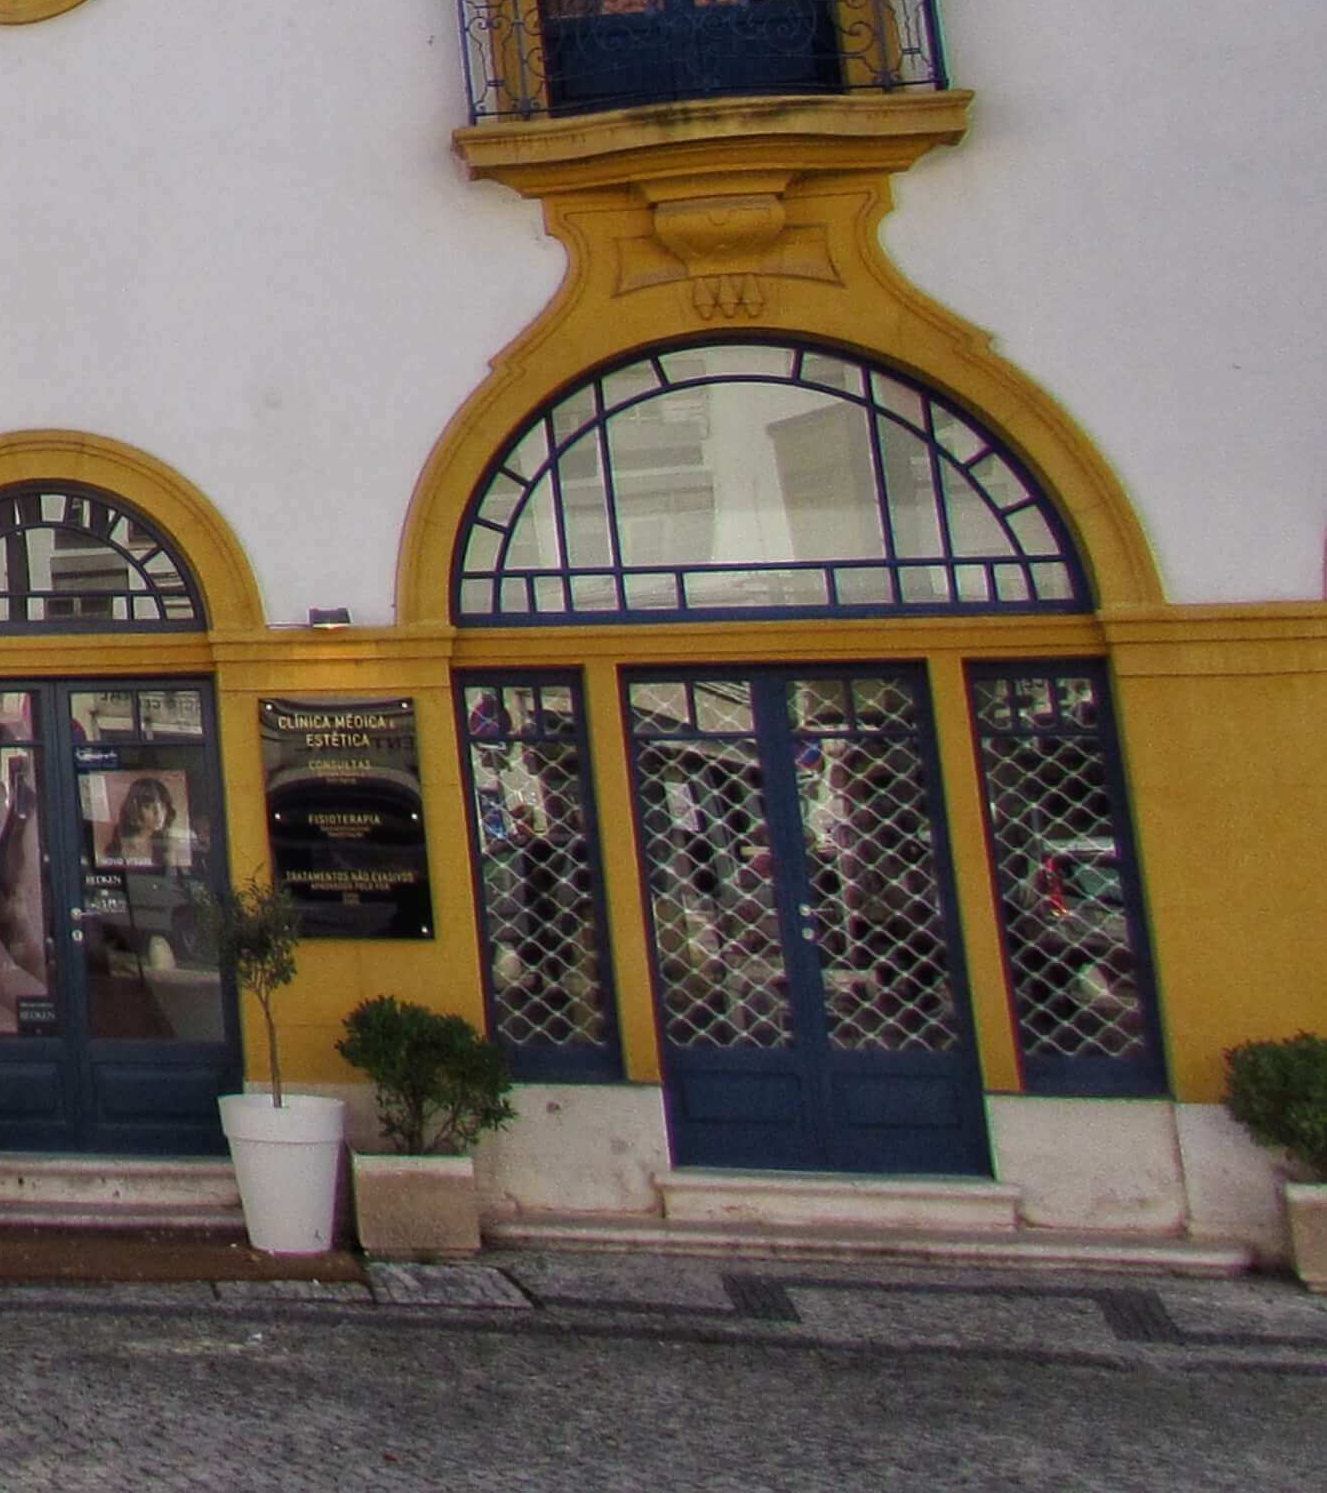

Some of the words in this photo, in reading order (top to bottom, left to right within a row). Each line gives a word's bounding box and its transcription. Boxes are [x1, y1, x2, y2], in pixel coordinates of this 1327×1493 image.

[278, 713, 331, 730] CLÍNICA
[334, 713, 386, 729] MÉDICA
[306, 731, 370, 747] ESTÉTICA
[308, 759, 372, 771] CONSULTAS
[308, 814, 381, 825] FISIOTERAPIA
[286, 870, 348, 882] TRATAMENTOS
[351, 869, 369, 882] NÃO
